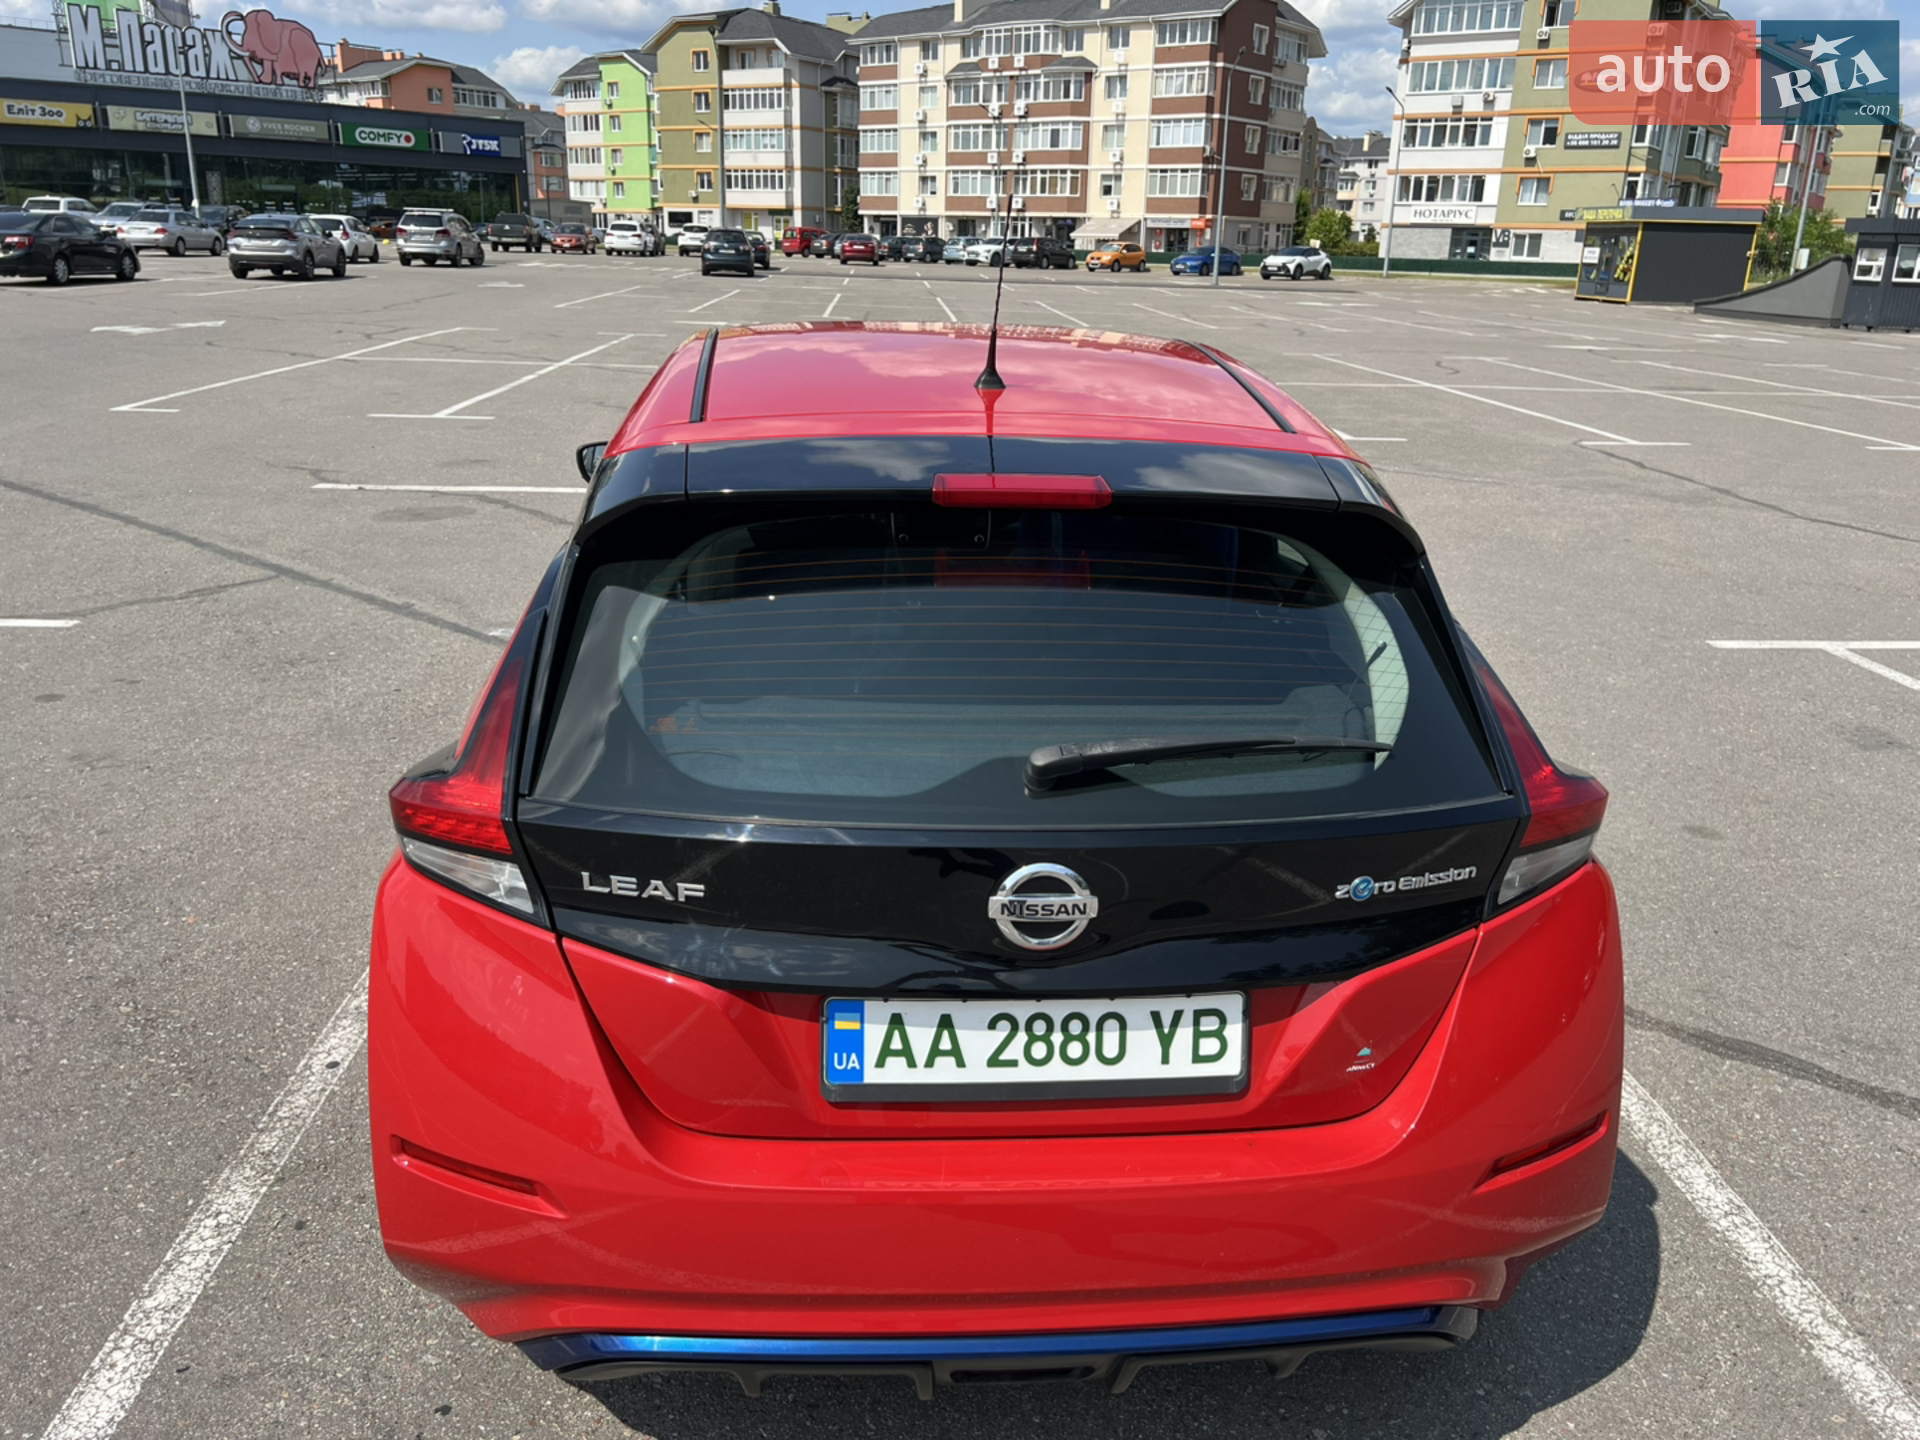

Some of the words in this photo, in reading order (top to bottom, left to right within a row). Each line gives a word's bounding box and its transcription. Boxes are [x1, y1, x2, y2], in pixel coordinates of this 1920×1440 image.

[6, 104, 37, 117] Еліт
[40, 105, 64, 118] Зоо
[262, 122, 282, 130] YVES
[284, 124, 316, 132] ROCHER
[358, 130, 403, 144] COMFY
[471, 139, 500, 152] JYSK
[1413, 208, 1474, 219] НОТАРІУС
[1398, 866, 1477, 891] Emission
[581, 871, 705, 902] LEAF
[1000, 903, 1087, 917] NISSAN
[874, 1012, 966, 1069] AA
[986, 1011, 1127, 1068] 2880
[1149, 1008, 1228, 1065] YB
[834, 1053, 860, 1070] UA
